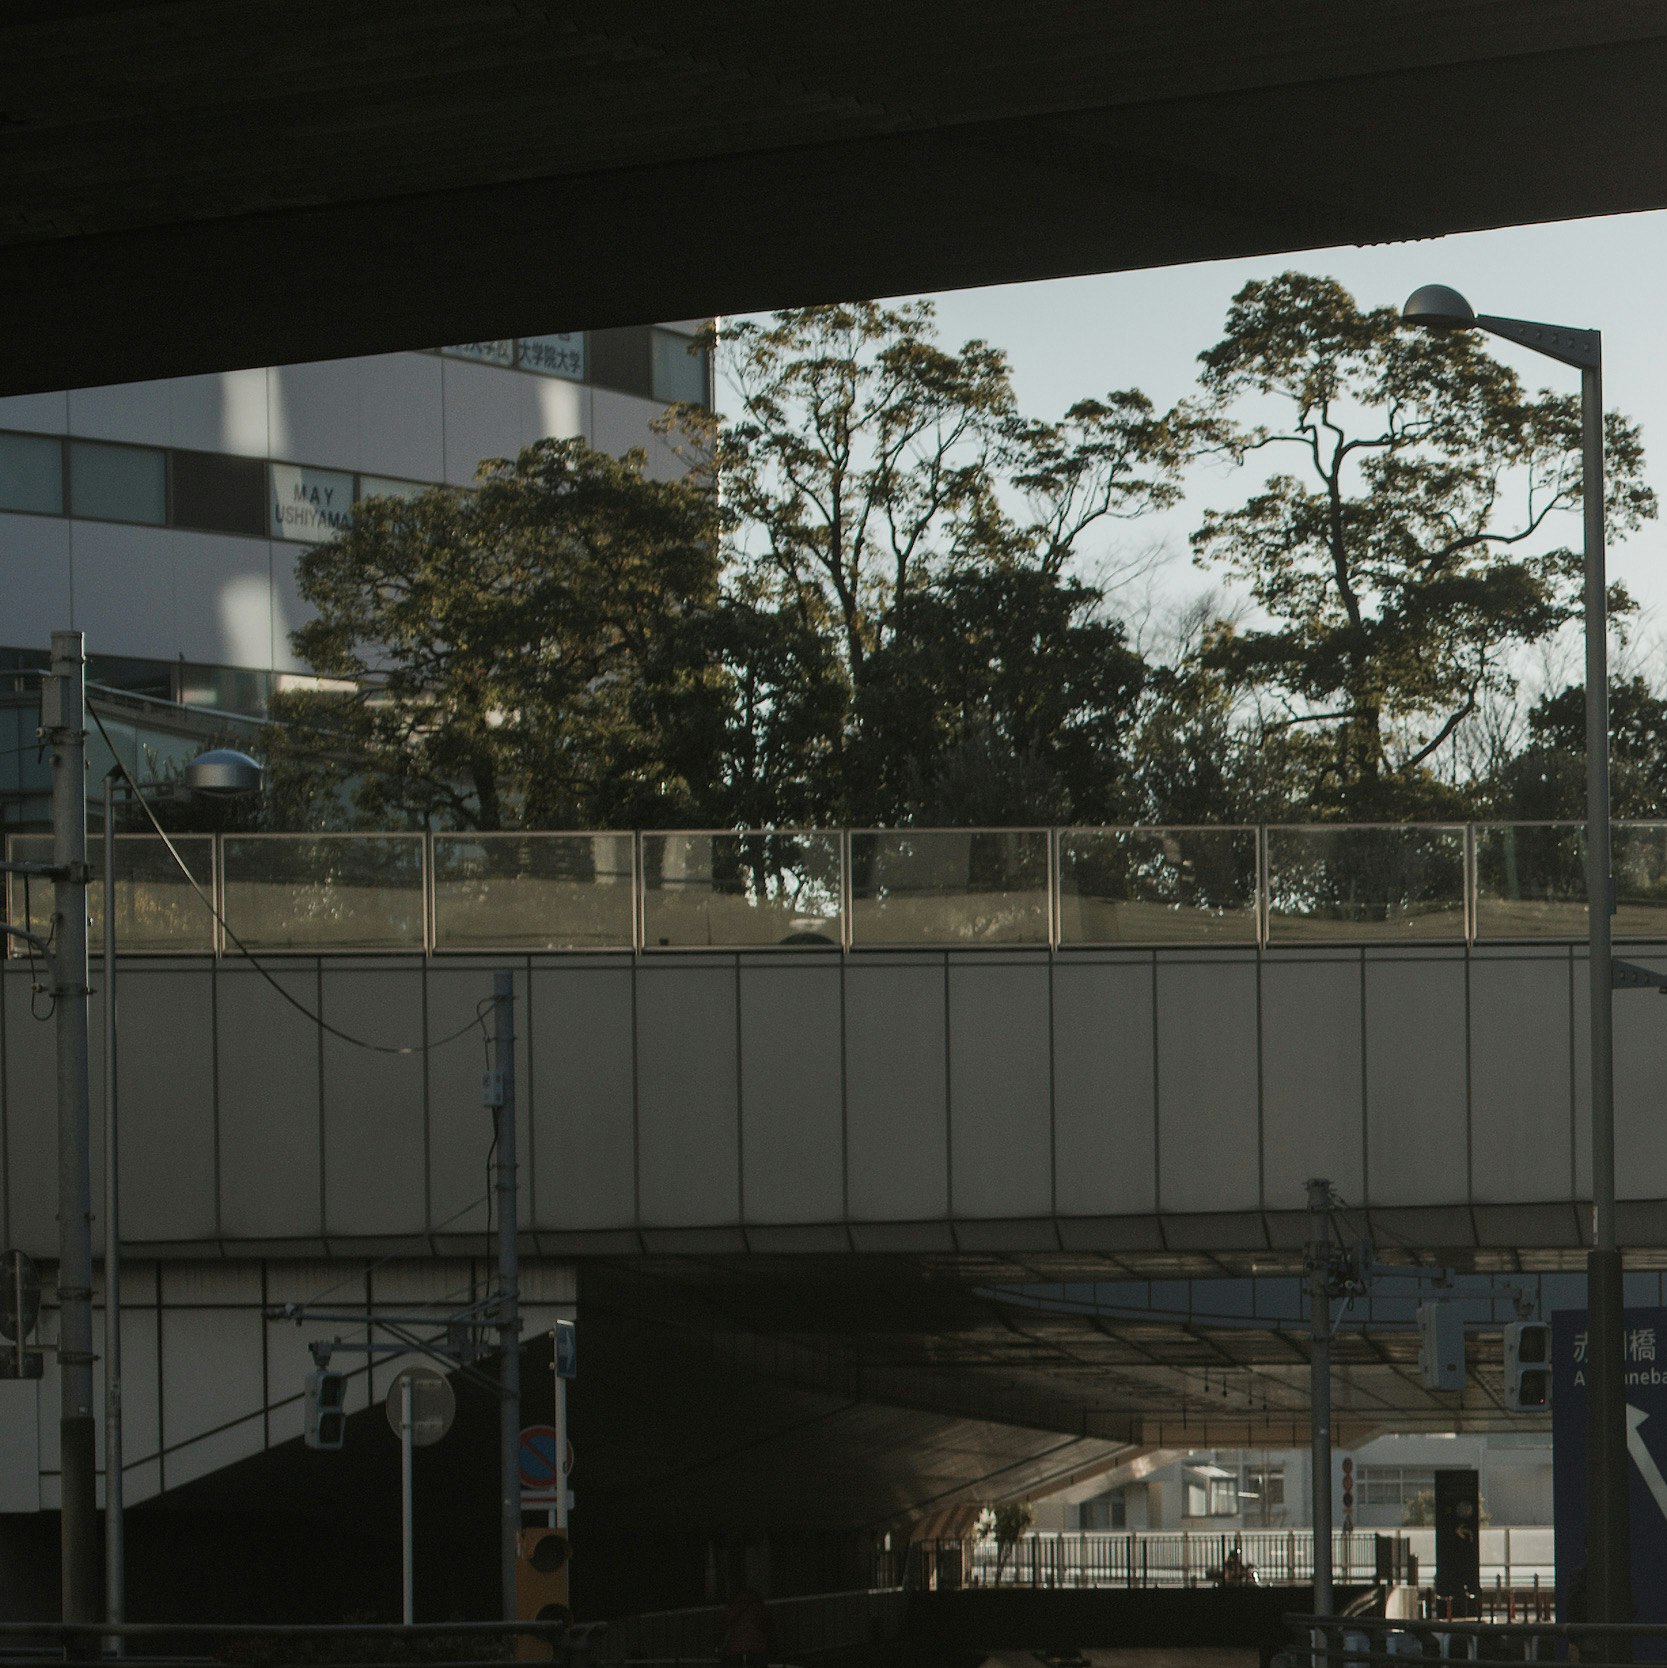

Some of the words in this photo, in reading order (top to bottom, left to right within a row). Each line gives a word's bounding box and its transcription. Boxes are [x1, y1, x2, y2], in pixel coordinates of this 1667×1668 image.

[293, 483, 333, 507] MAY
[275, 504, 350, 529] USHIYAMA
[1573, 1328, 1656, 1363] 赤橋
